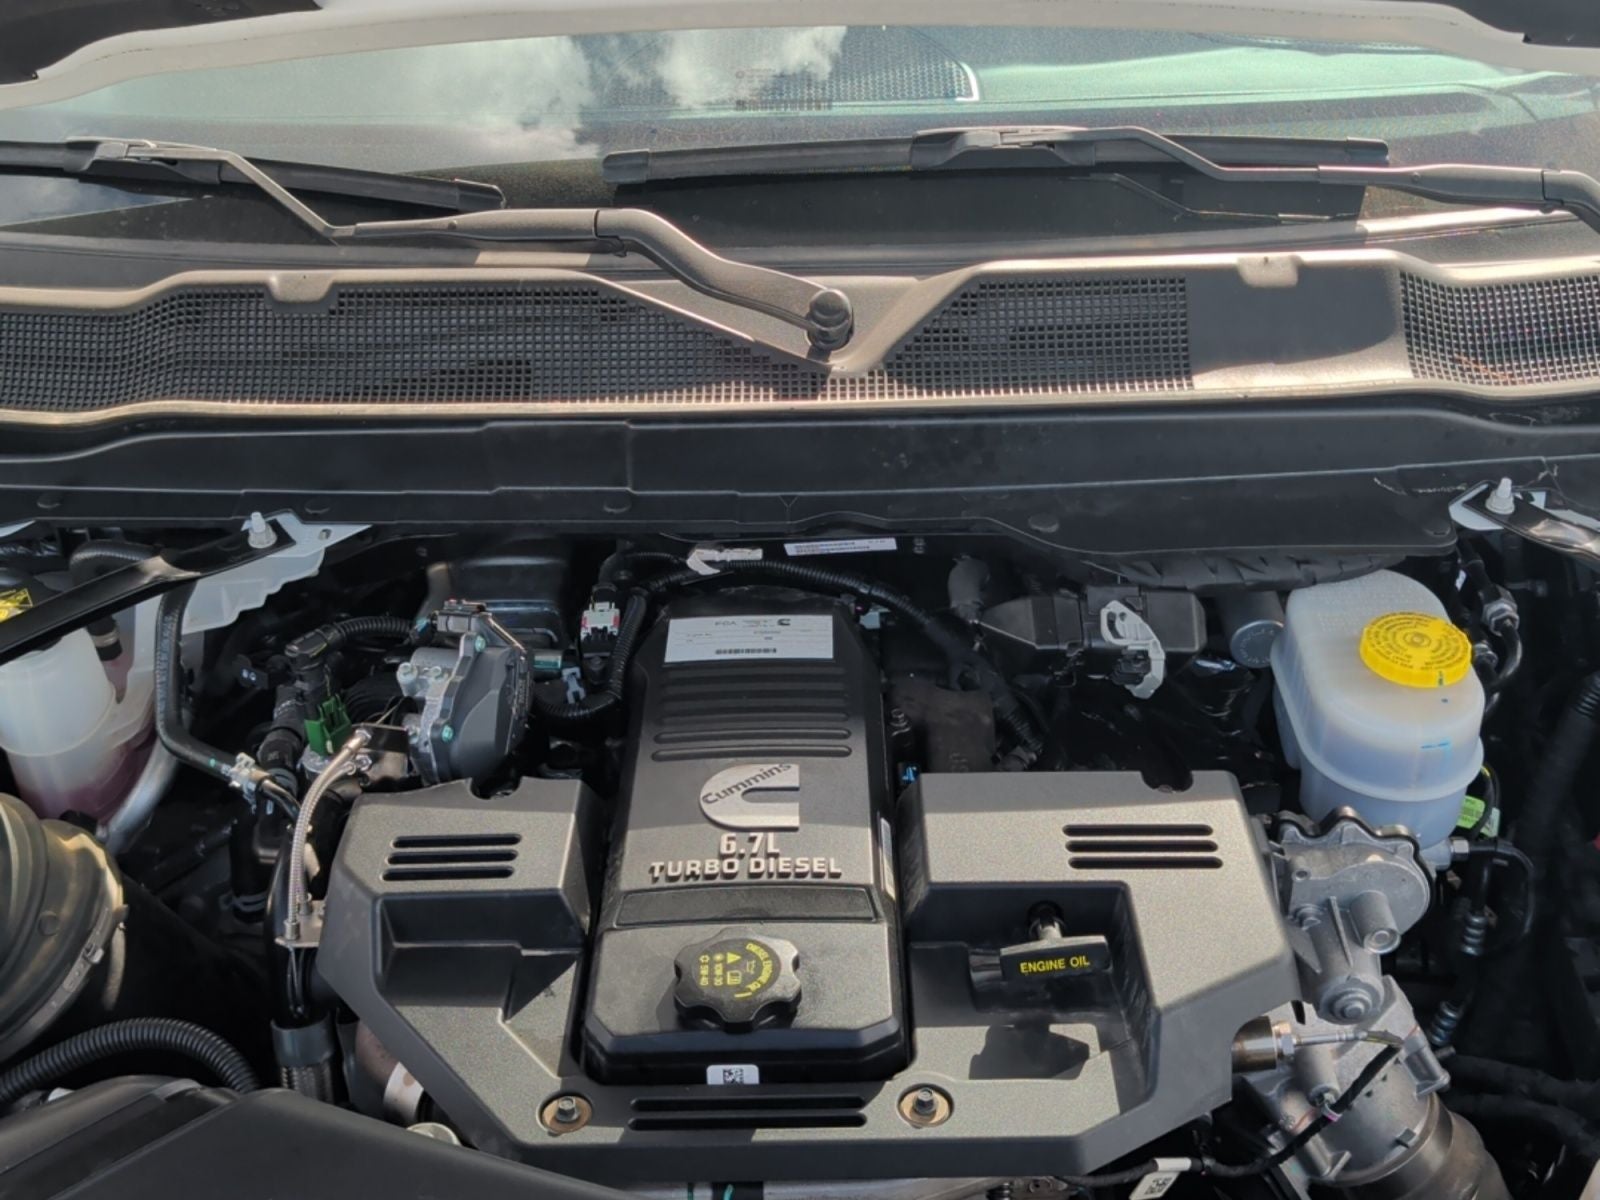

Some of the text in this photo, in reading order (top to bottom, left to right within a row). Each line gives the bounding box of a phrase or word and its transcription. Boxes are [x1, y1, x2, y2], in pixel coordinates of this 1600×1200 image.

[702, 763, 792, 805] Cummins
[719, 833, 781, 858] 6.7L
[650, 857, 842, 881] TURBO DIESEL
[1020, 955, 1090, 974] ENGINE OIL
